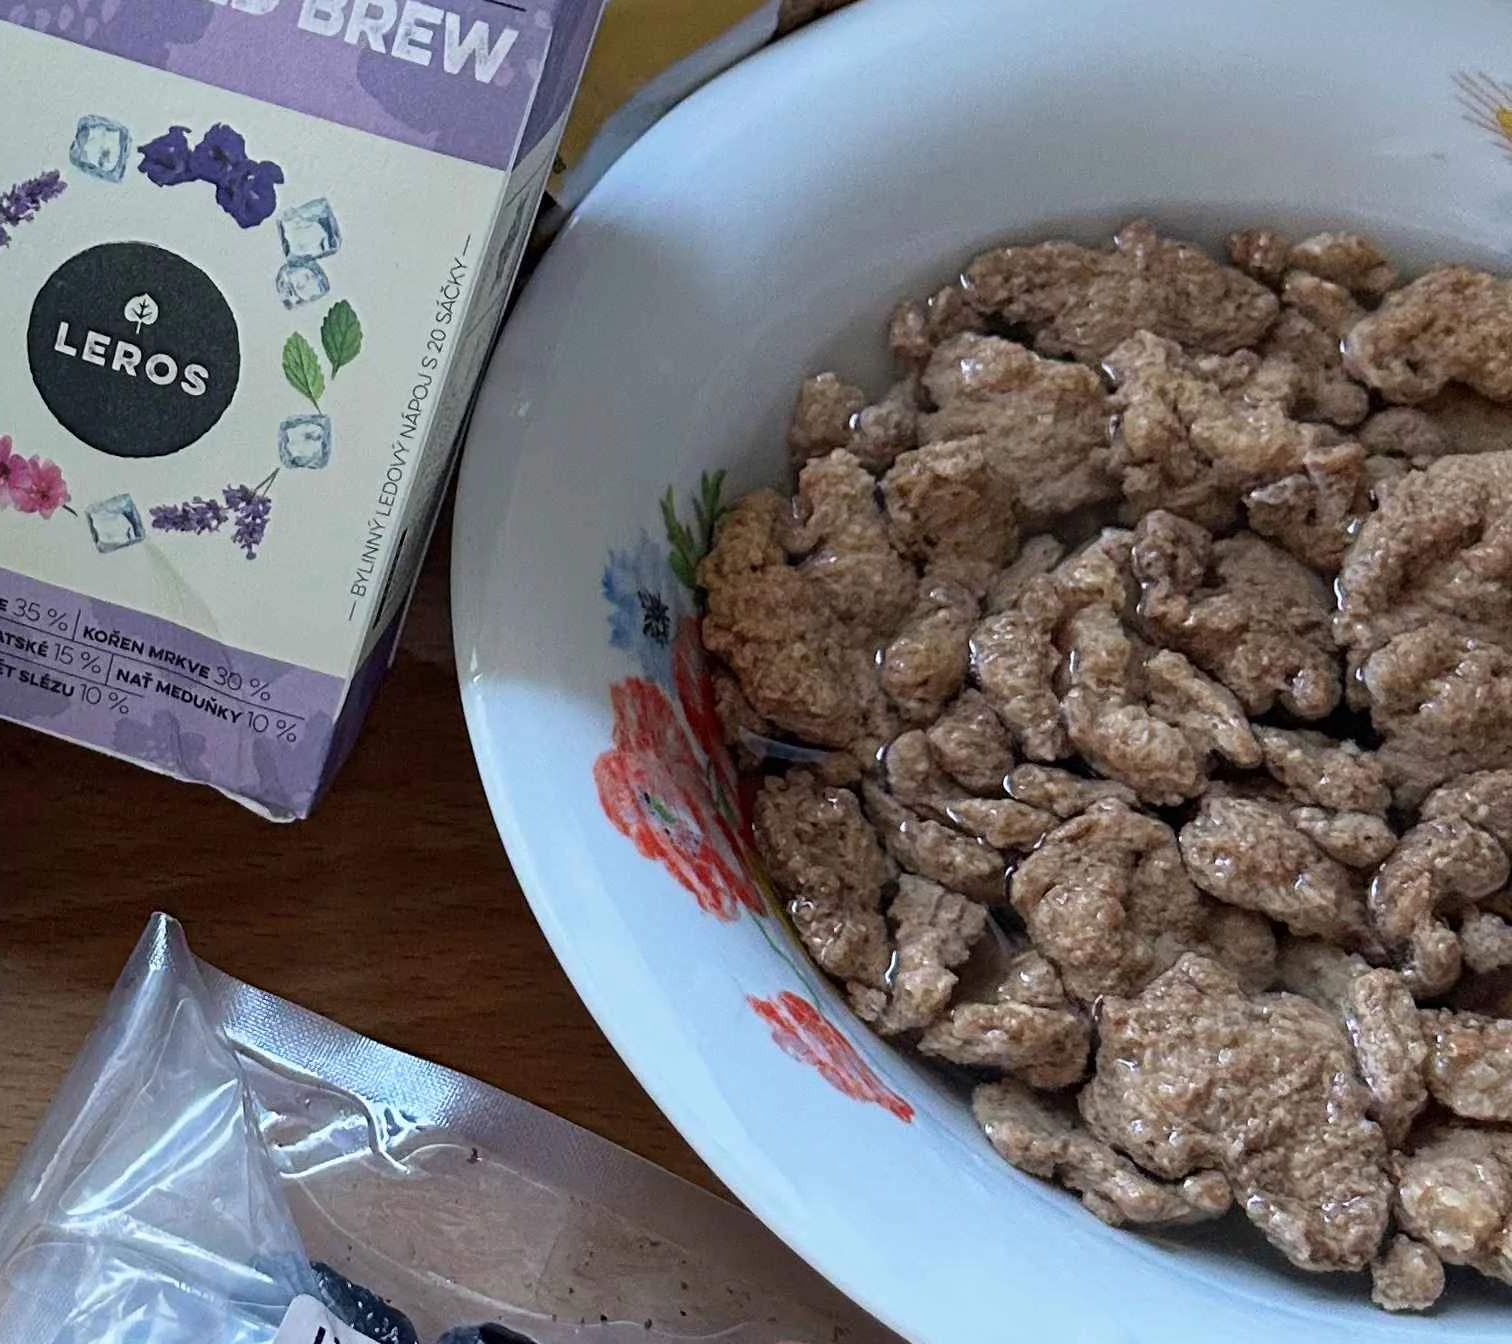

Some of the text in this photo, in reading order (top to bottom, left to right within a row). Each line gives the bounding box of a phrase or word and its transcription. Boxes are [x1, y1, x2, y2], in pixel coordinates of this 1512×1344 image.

[54, 321, 210, 397] LEROS
[350, 257, 467, 597] BYLINNÝ LEDOVÝ NÁPOJ S 20 SÁČKY
[13, 598, 40, 622] 35
[47, 608, 68, 631] %
[19, 670, 75, 697] SLÉZU
[81, 683, 102, 705] 10
[108, 692, 129, 714] %
[54, 643, 74, 665] 15
[80, 651, 101, 674] %
[83, 626, 271, 702] KOŘEN MRKVE 30 %
[116, 668, 297, 742] NAŤ MEDUŇKY 10 %
